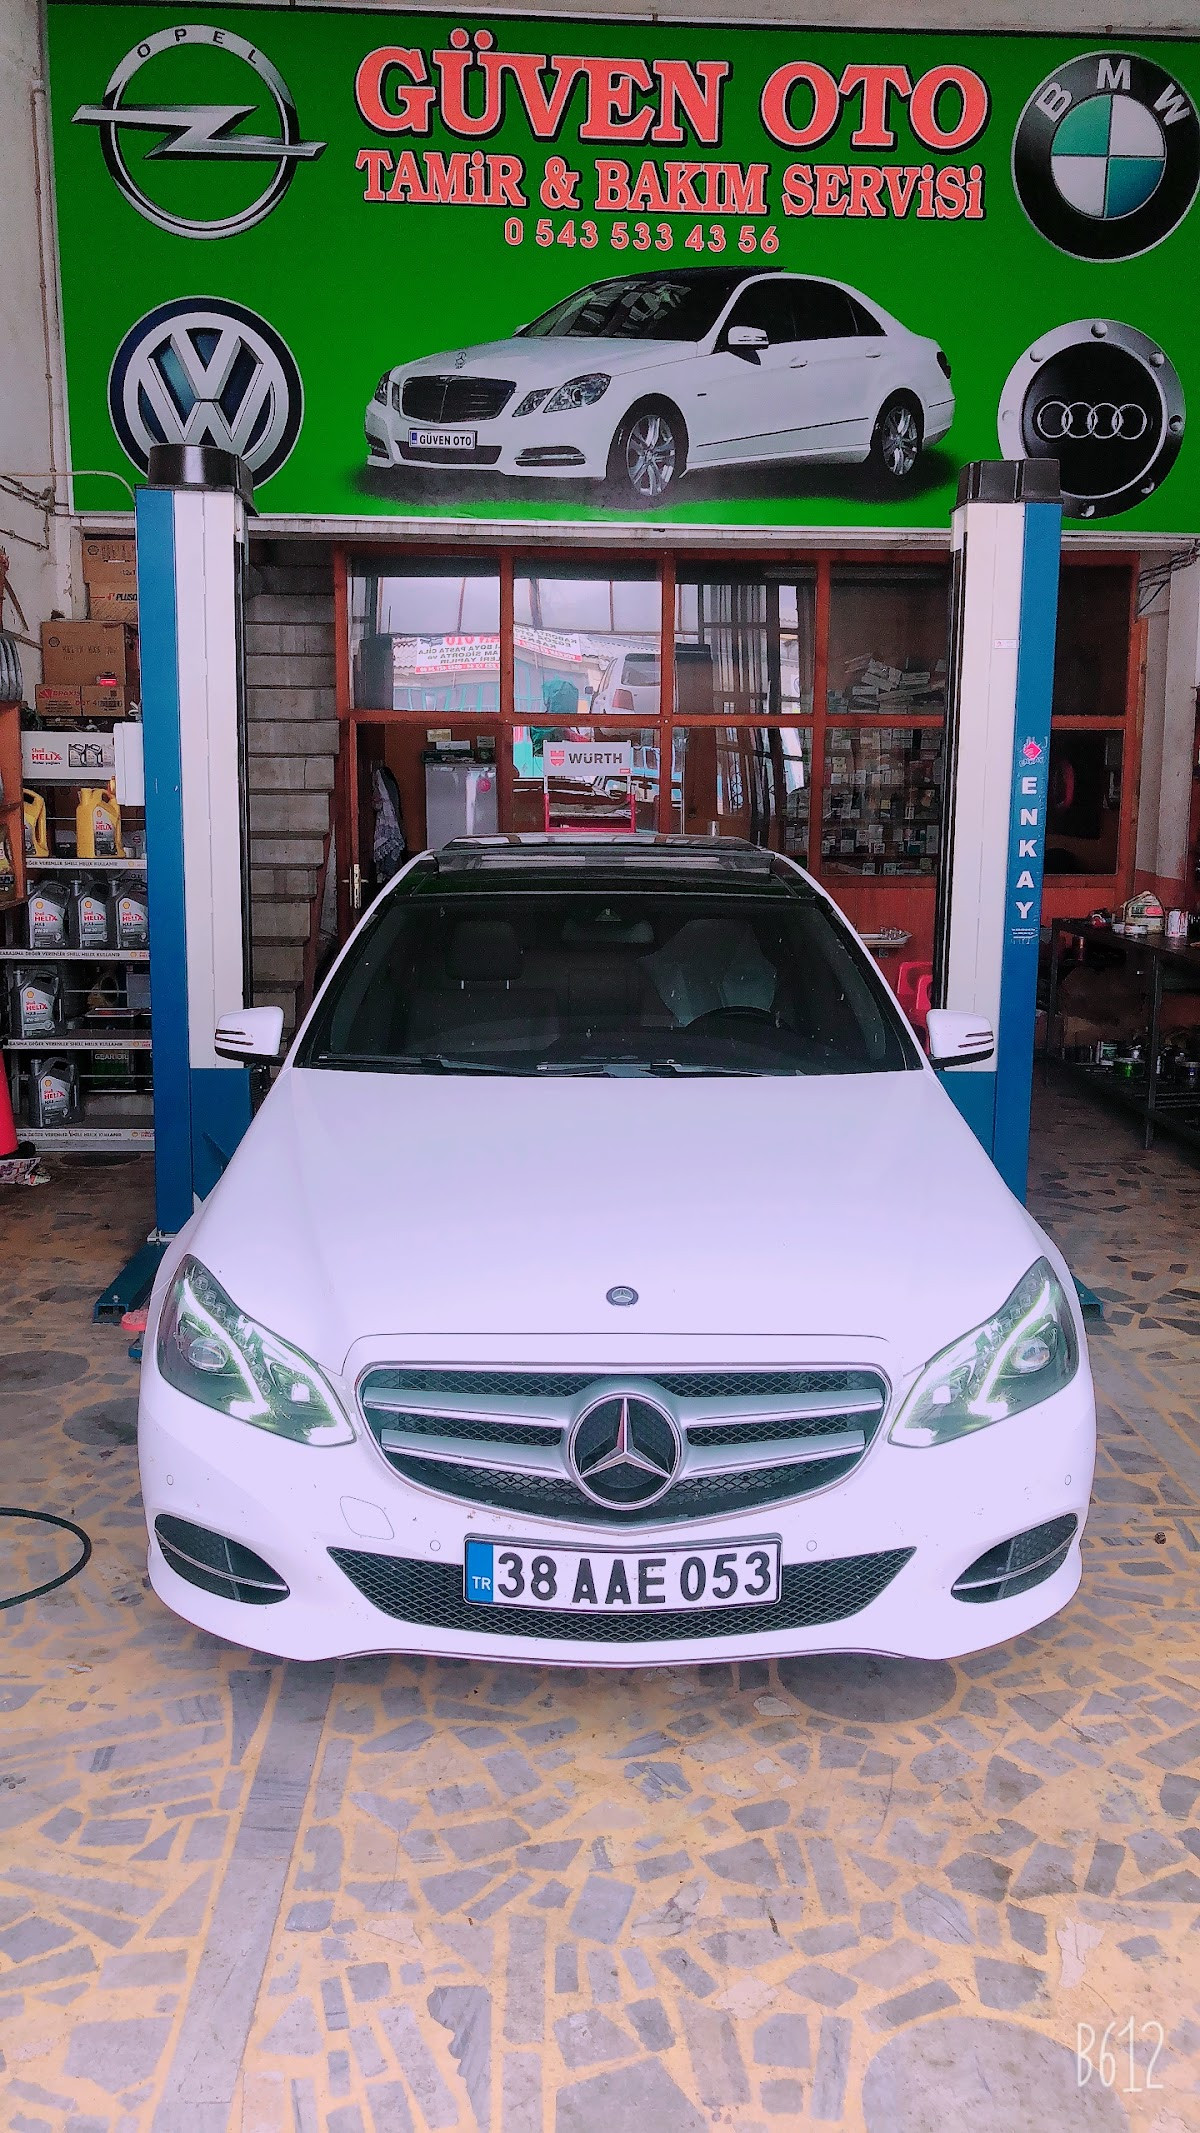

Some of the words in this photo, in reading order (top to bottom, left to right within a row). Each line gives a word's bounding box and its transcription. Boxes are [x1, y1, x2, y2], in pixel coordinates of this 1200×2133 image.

[137, 28, 257, 65] OPEL
[356, 28, 730, 143] GÜVEN
[760, 60, 989, 150] OTO
[1034, 58, 1192, 126] BMW
[539, 156, 580, 209] &
[594, 159, 770, 215] BAKIM
[504, 216, 524, 246] 0
[535, 218, 599, 249] 543
[610, 221, 674, 251] 533
[685, 224, 727, 253] 43
[737, 225, 780, 254] 56
[419, 432, 451, 445] GÜVEN
[453, 436, 472, 446] OTO
[31, 752, 63, 761] HELIX
[568, 752, 623, 764] WÜRTH
[1015, 776, 1040, 920] ENKAY
[34, 913, 58, 921] HELIX
[83, 913, 105, 921] HELIX
[122, 913, 144, 921] HELIX
[26, 1003, 48, 1011] HELIX
[44, 1091, 66, 1100] HELIX
[471, 1575, 492, 1592] TR
[497, 1552, 558, 1601] 38
[571, 1557, 668, 1605] AAE
[679, 1550, 772, 1602] 053
